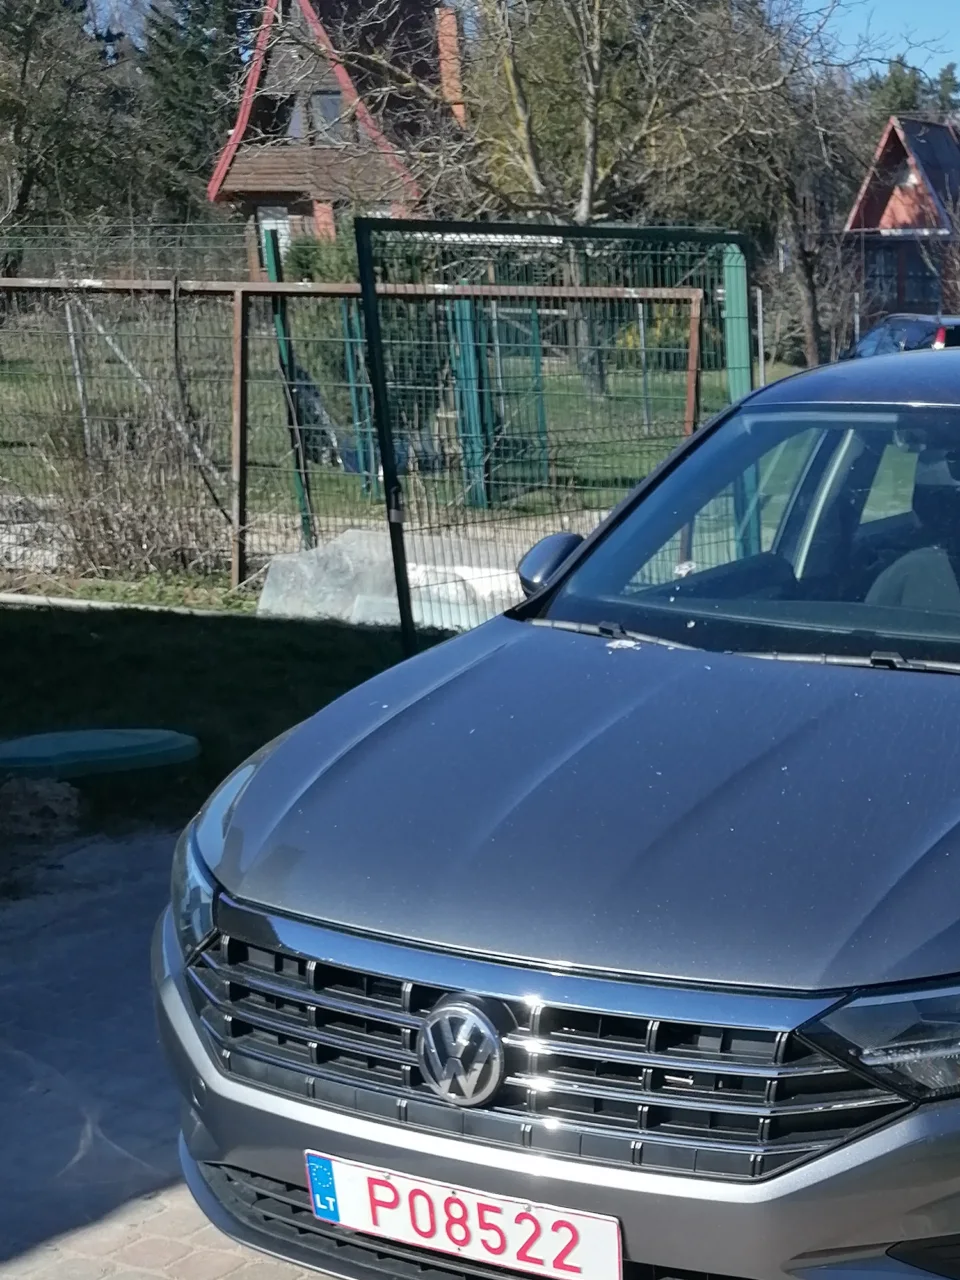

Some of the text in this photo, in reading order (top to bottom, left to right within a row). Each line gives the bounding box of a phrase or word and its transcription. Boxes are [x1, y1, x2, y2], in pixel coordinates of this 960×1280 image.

[417, 1002, 502, 1107] VW
[314, 1193, 336, 1212] LT
[366, 1176, 582, 1275] P08522
